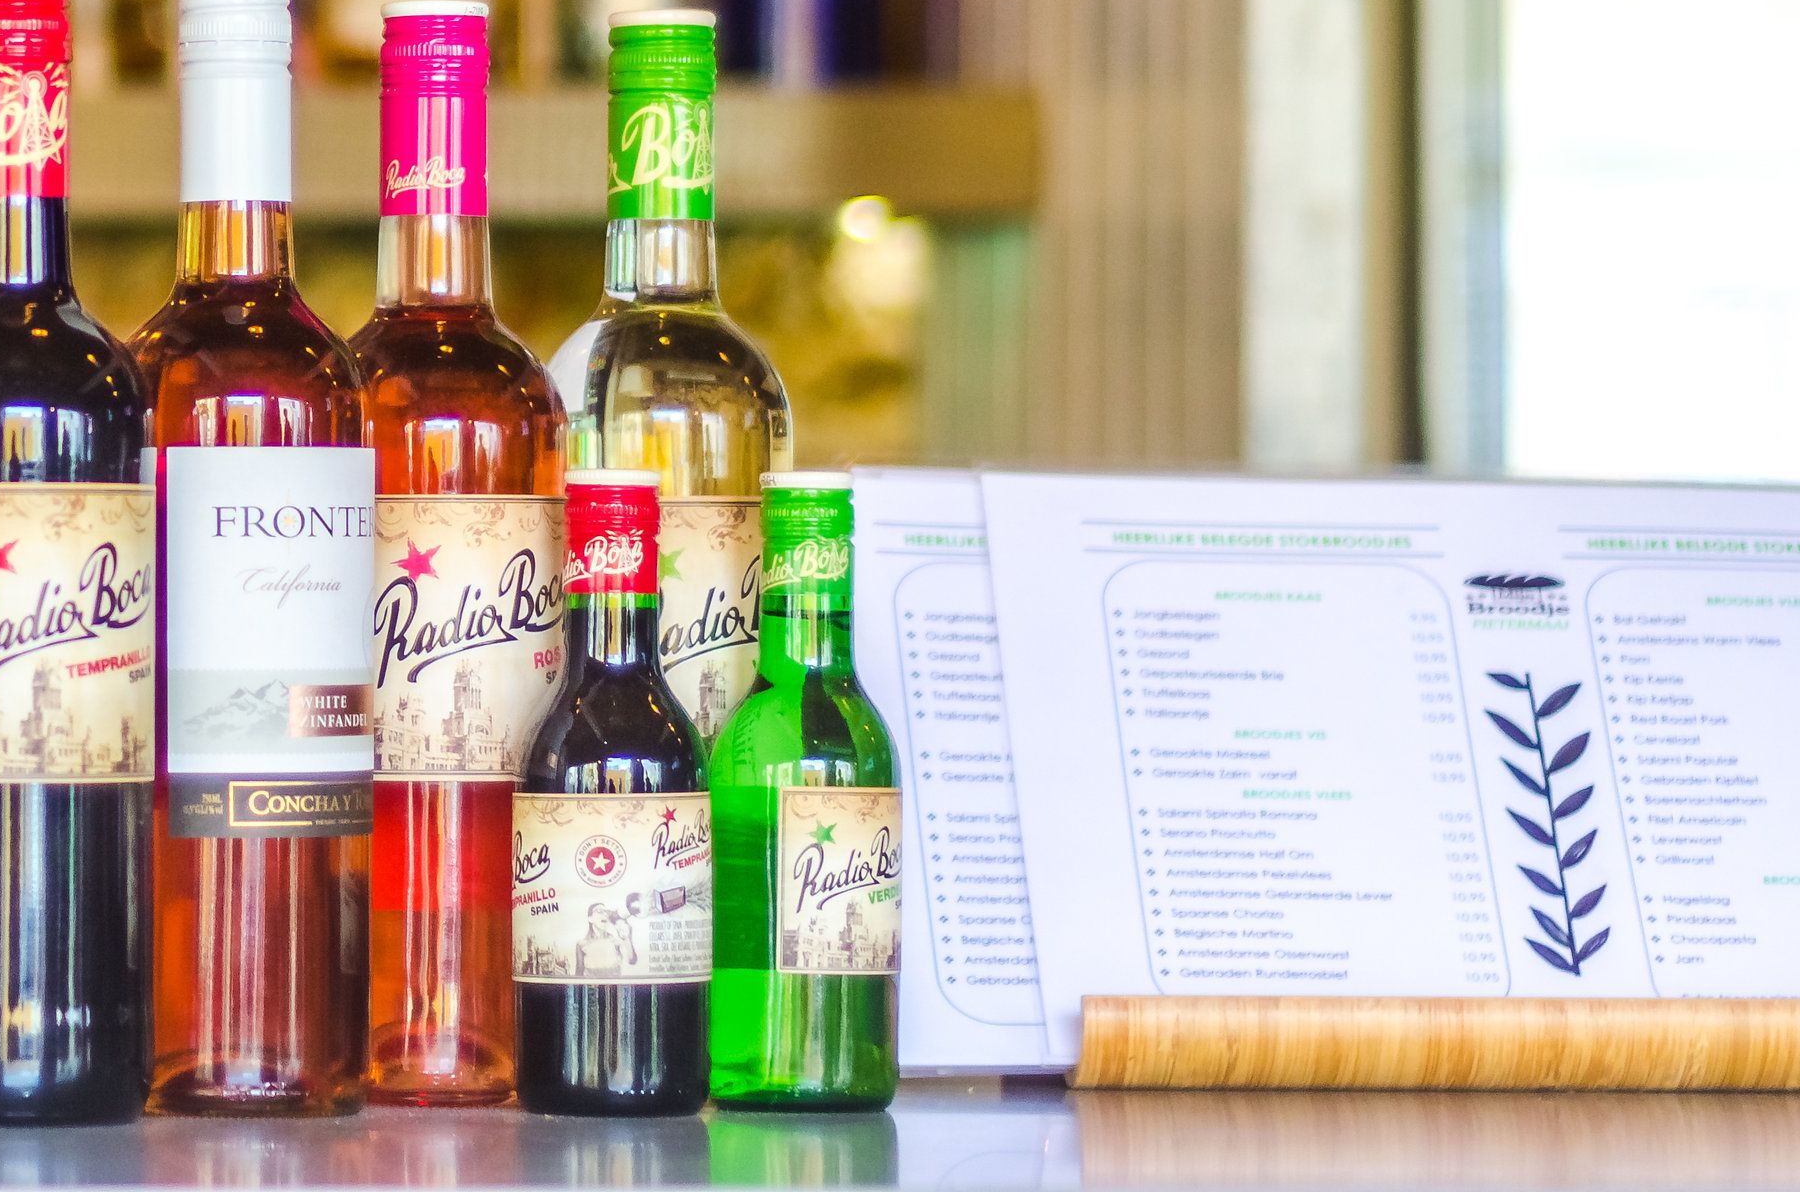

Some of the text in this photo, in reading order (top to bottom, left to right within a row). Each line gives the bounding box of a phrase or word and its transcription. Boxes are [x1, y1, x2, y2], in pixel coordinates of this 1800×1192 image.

[385, 155, 465, 199] Radio Boca
[562, 536, 644, 587] dio Boa
[1112, 531, 1196, 546] HEERLIJKE
[1201, 532, 1274, 547] BELEGDE
[234, 564, 343, 610] California
[761, 539, 849, 593] adio Boa
[373, 575, 519, 689] Radio
[659, 586, 758, 676] adio
[533, 646, 561, 670] ROS
[301, 694, 348, 709] WHITE
[652, 822, 700, 870] Radio
[512, 887, 557, 911] PRANILLO
[793, 842, 880, 914] Radio
[867, 886, 901, 905] VERD
[530, 903, 560, 917] SPAIN
